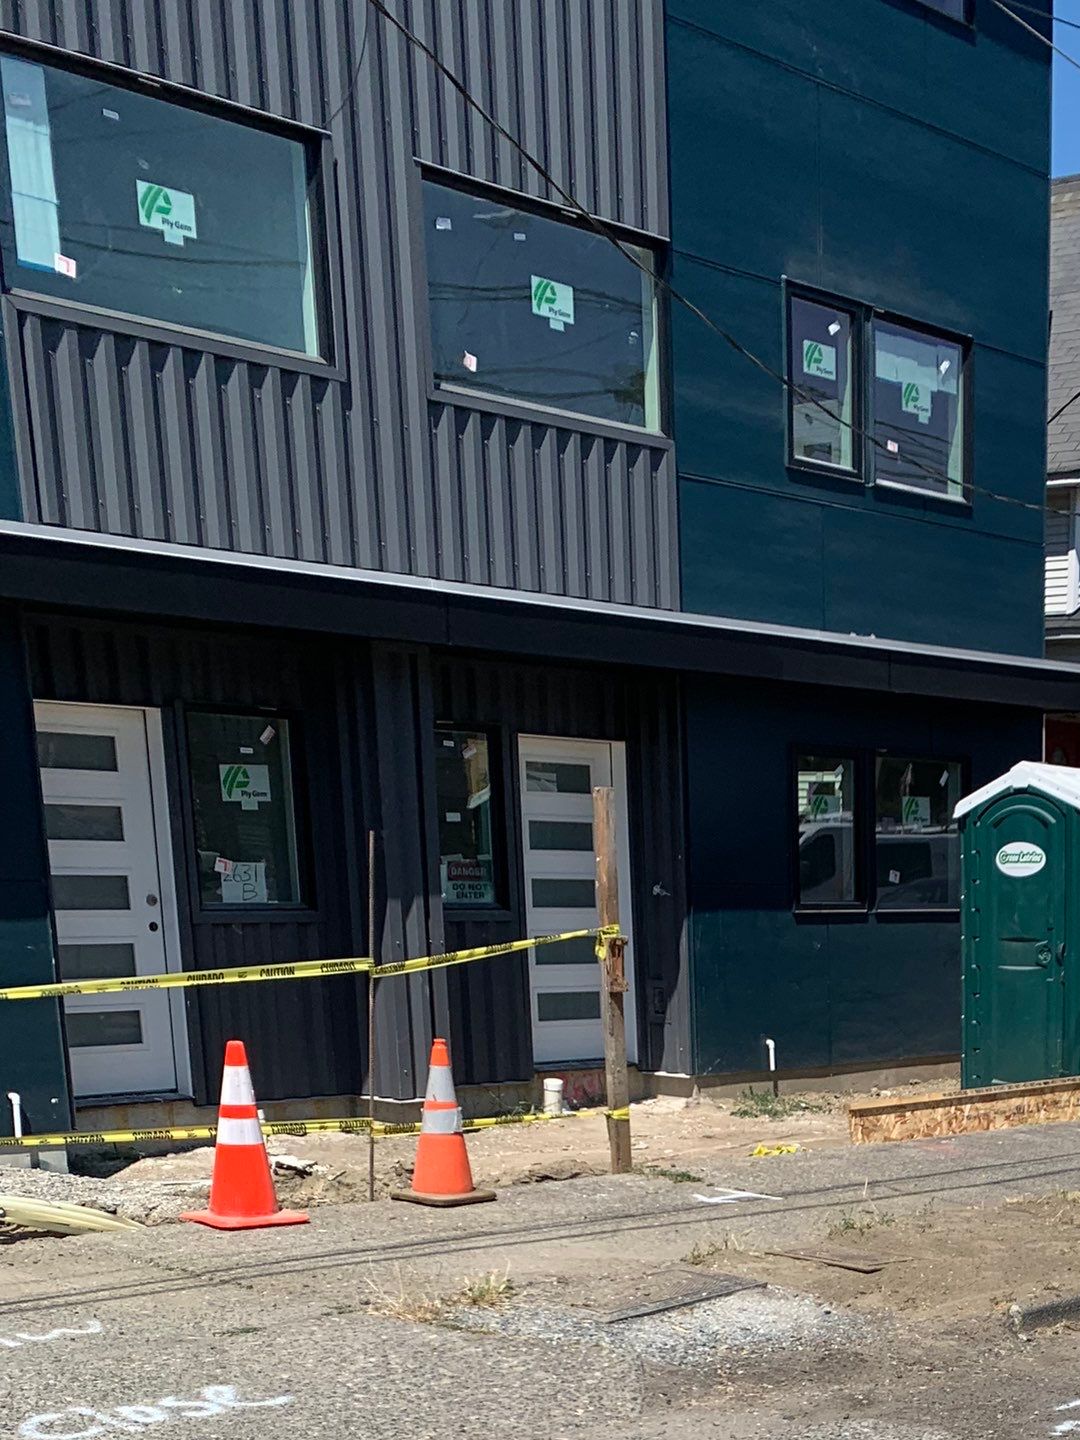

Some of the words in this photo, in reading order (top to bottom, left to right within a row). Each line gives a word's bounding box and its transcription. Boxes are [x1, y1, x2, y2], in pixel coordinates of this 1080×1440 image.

[450, 866, 488, 877] DANGER
[242, 883, 258, 901] B
[452, 883, 466, 891] DO
[468, 883, 488, 891] NOT
[456, 891, 485, 899] ENTER
[259, 966, 296, 978] CAUTION
